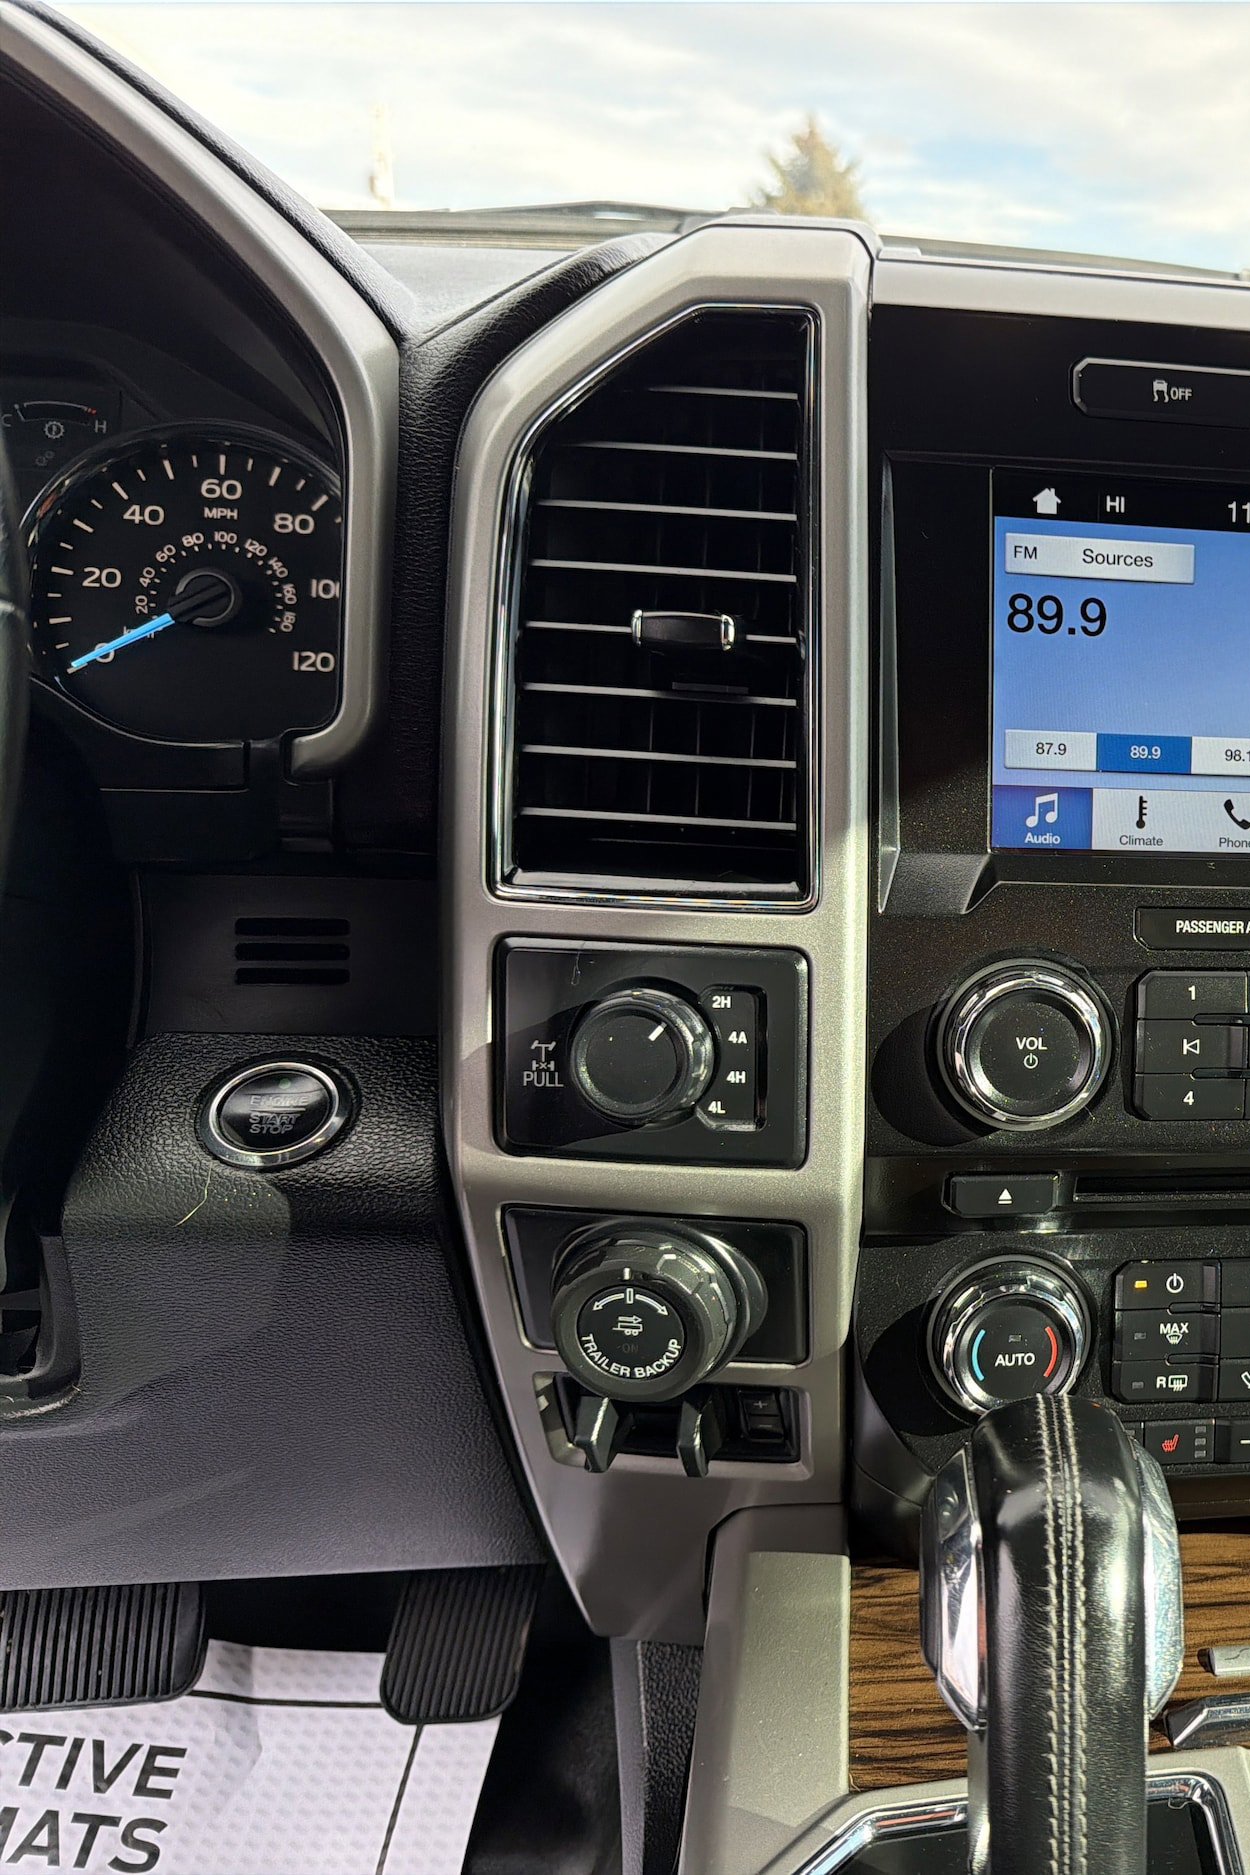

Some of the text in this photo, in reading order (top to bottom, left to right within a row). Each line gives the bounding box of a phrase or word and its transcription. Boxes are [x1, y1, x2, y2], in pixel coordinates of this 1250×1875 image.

[1170, 386, 1193, 402] OFF
[94, 419, 108, 434] H
[200, 479, 243, 500] 60
[1105, 495, 1126, 513] HI
[123, 505, 165, 526] 40
[203, 507, 239, 521] MPH
[273, 513, 315, 535] 80
[181, 531, 205, 548] 80
[213, 531, 238, 545] 100
[155, 544, 177, 564] 60
[244, 538, 268, 558] 120
[1013, 545, 1039, 560] FM
[1082, 548, 1154, 569] Sources
[268, 557, 289, 579] 140
[81, 567, 122, 588] 20
[139, 567, 156, 589] 40
[281, 584, 297, 605] 160
[311, 578, 340, 599] 10
[135, 595, 149, 615] 20
[1006, 593, 1108, 637] 89.9
[292, 650, 335, 673] 120
[1035, 742, 1067, 756] 87.9
[1130, 745, 1161, 760] 89.9
[1024, 832, 1061, 845] Audio
[1119, 834, 1164, 848] Climate
[1175, 920, 1244, 934] PASSENGER
[1187, 984, 1197, 1000] 1
[711, 995, 732, 1010] 2H
[727, 1030, 748, 1045] 4A
[1015, 1036, 1048, 1051] VOL
[522, 1070, 564, 1088] PULL
[725, 1070, 747, 1084] 4H
[250, 1095, 310, 1107] ENGINE
[1182, 1090, 1195, 1106] 4
[707, 1100, 727, 1115] 4L
[249, 1112, 300, 1125] START
[249, 1124, 293, 1135] STOP
[1159, 1322, 1189, 1335] MAX
[580, 1333, 683, 1379] TRAILER BACKUP
[994, 1352, 1036, 1368] AUTO
[1156, 1375, 1167, 1389] R
